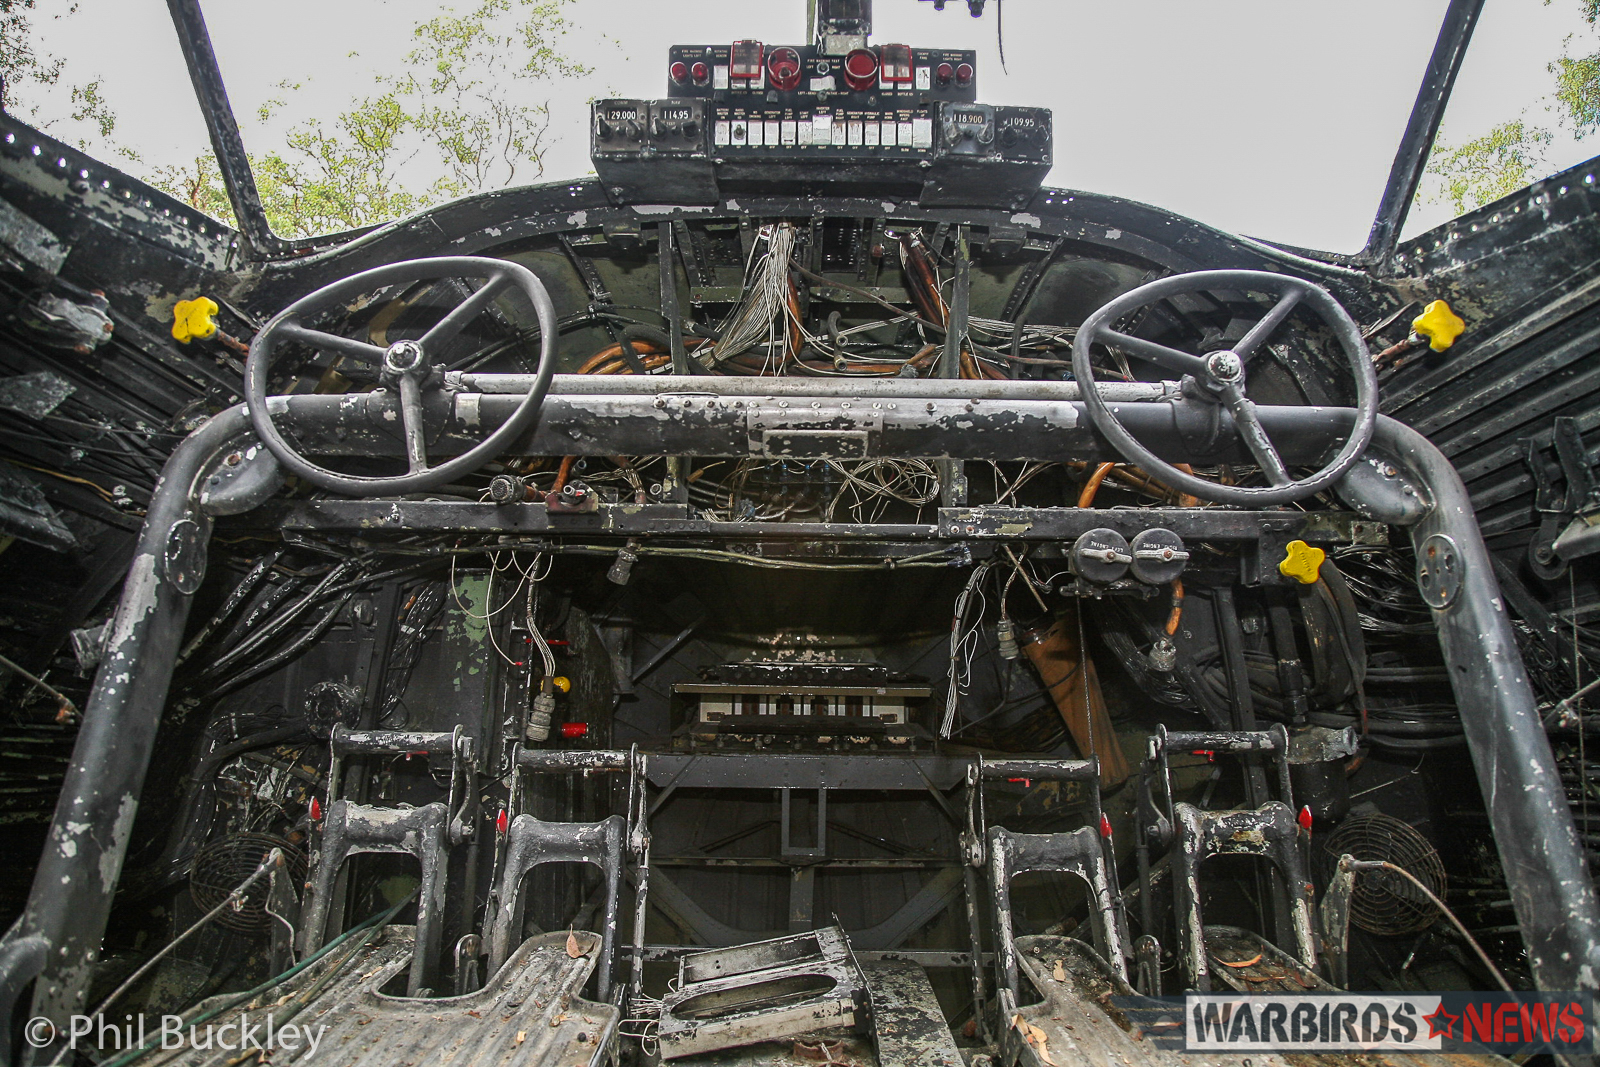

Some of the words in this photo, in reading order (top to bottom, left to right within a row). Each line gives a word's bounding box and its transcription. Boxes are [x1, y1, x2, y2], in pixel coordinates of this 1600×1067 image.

[606, 110, 636, 120] 129.000
[664, 110, 689, 120] 114.95
[953, 114, 983, 124] 118.900
[1010, 117, 1035, 127] 109.95
[1090, 540, 1109, 549] ENGINE
